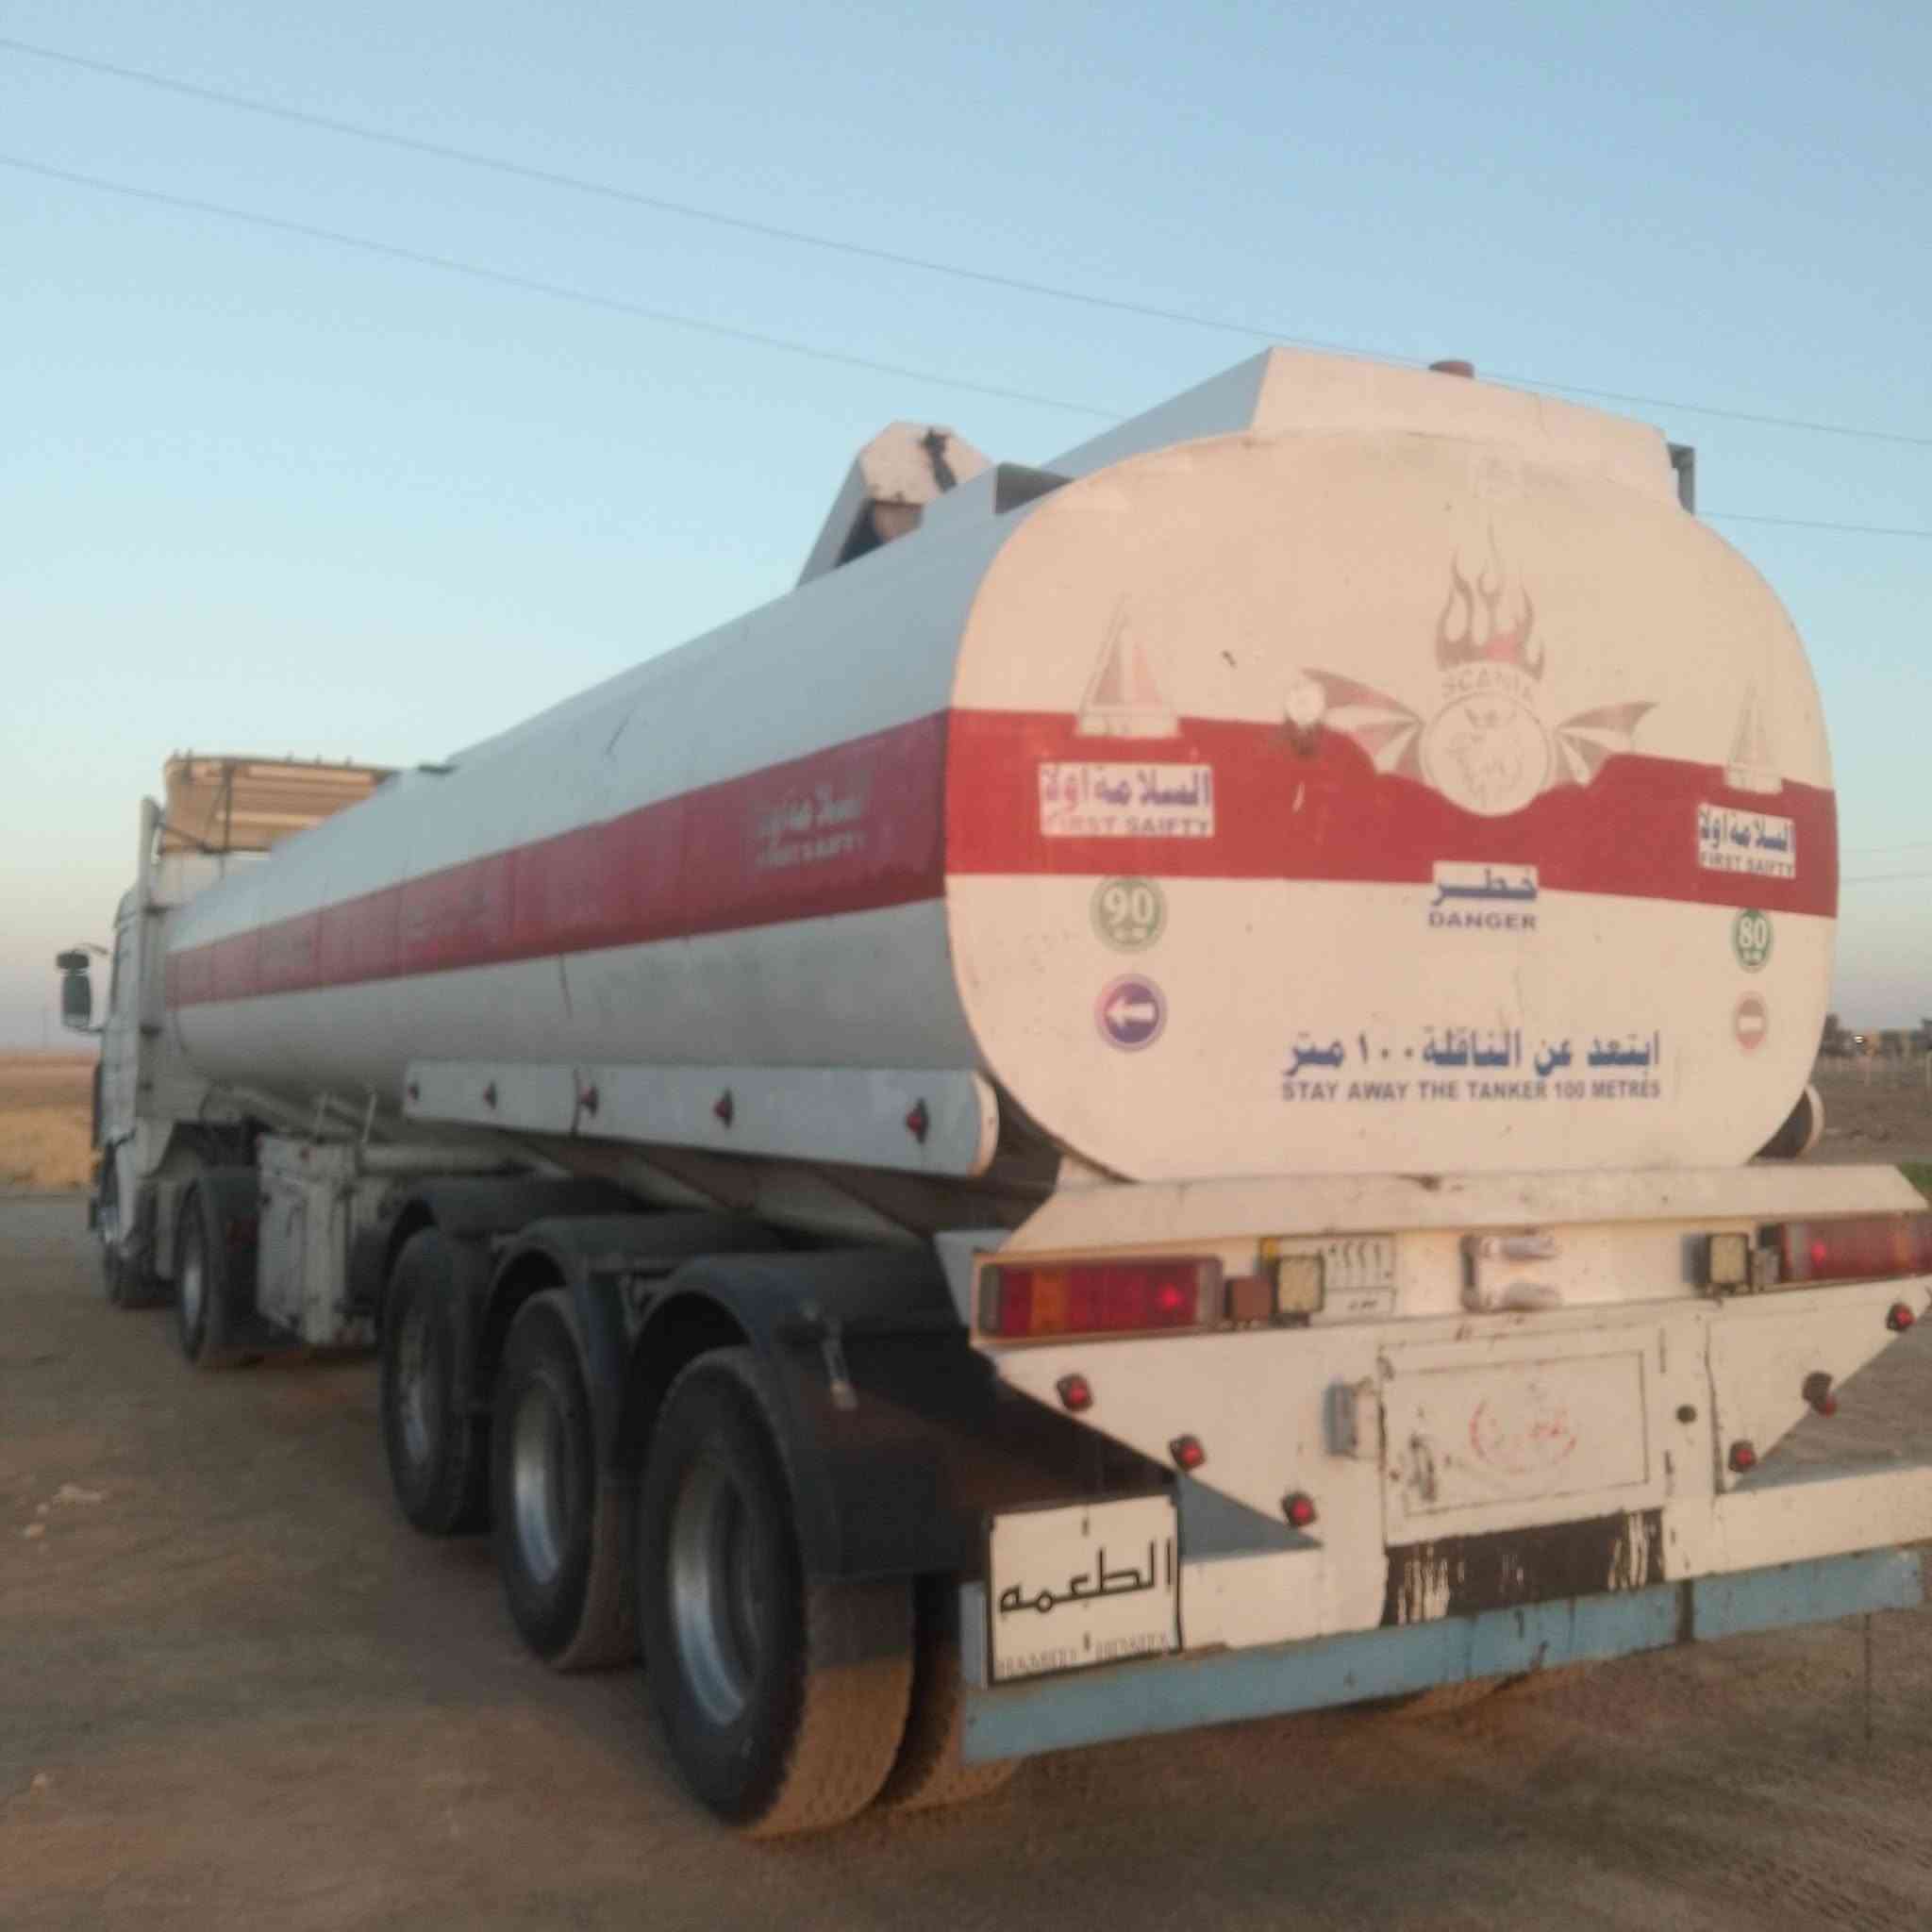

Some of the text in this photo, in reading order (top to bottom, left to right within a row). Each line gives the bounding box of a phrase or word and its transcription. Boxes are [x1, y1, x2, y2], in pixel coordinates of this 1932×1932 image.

[1102, 885, 1156, 925] 90
[1430, 867, 1538, 907] خطر
[1428, 912, 1537, 929] DANGER
[1739, 915, 1767, 949] 80
[1282, 1030, 1345, 1076] متر
[1422, 1025, 1521, 1068] الناقلة
[1533, 1038, 1573, 1076] عن
[1588, 1029, 1660, 1072] ابتعد
[1283, 1079, 1661, 1101] STAY AWAY THE TANKER 100 METRES
